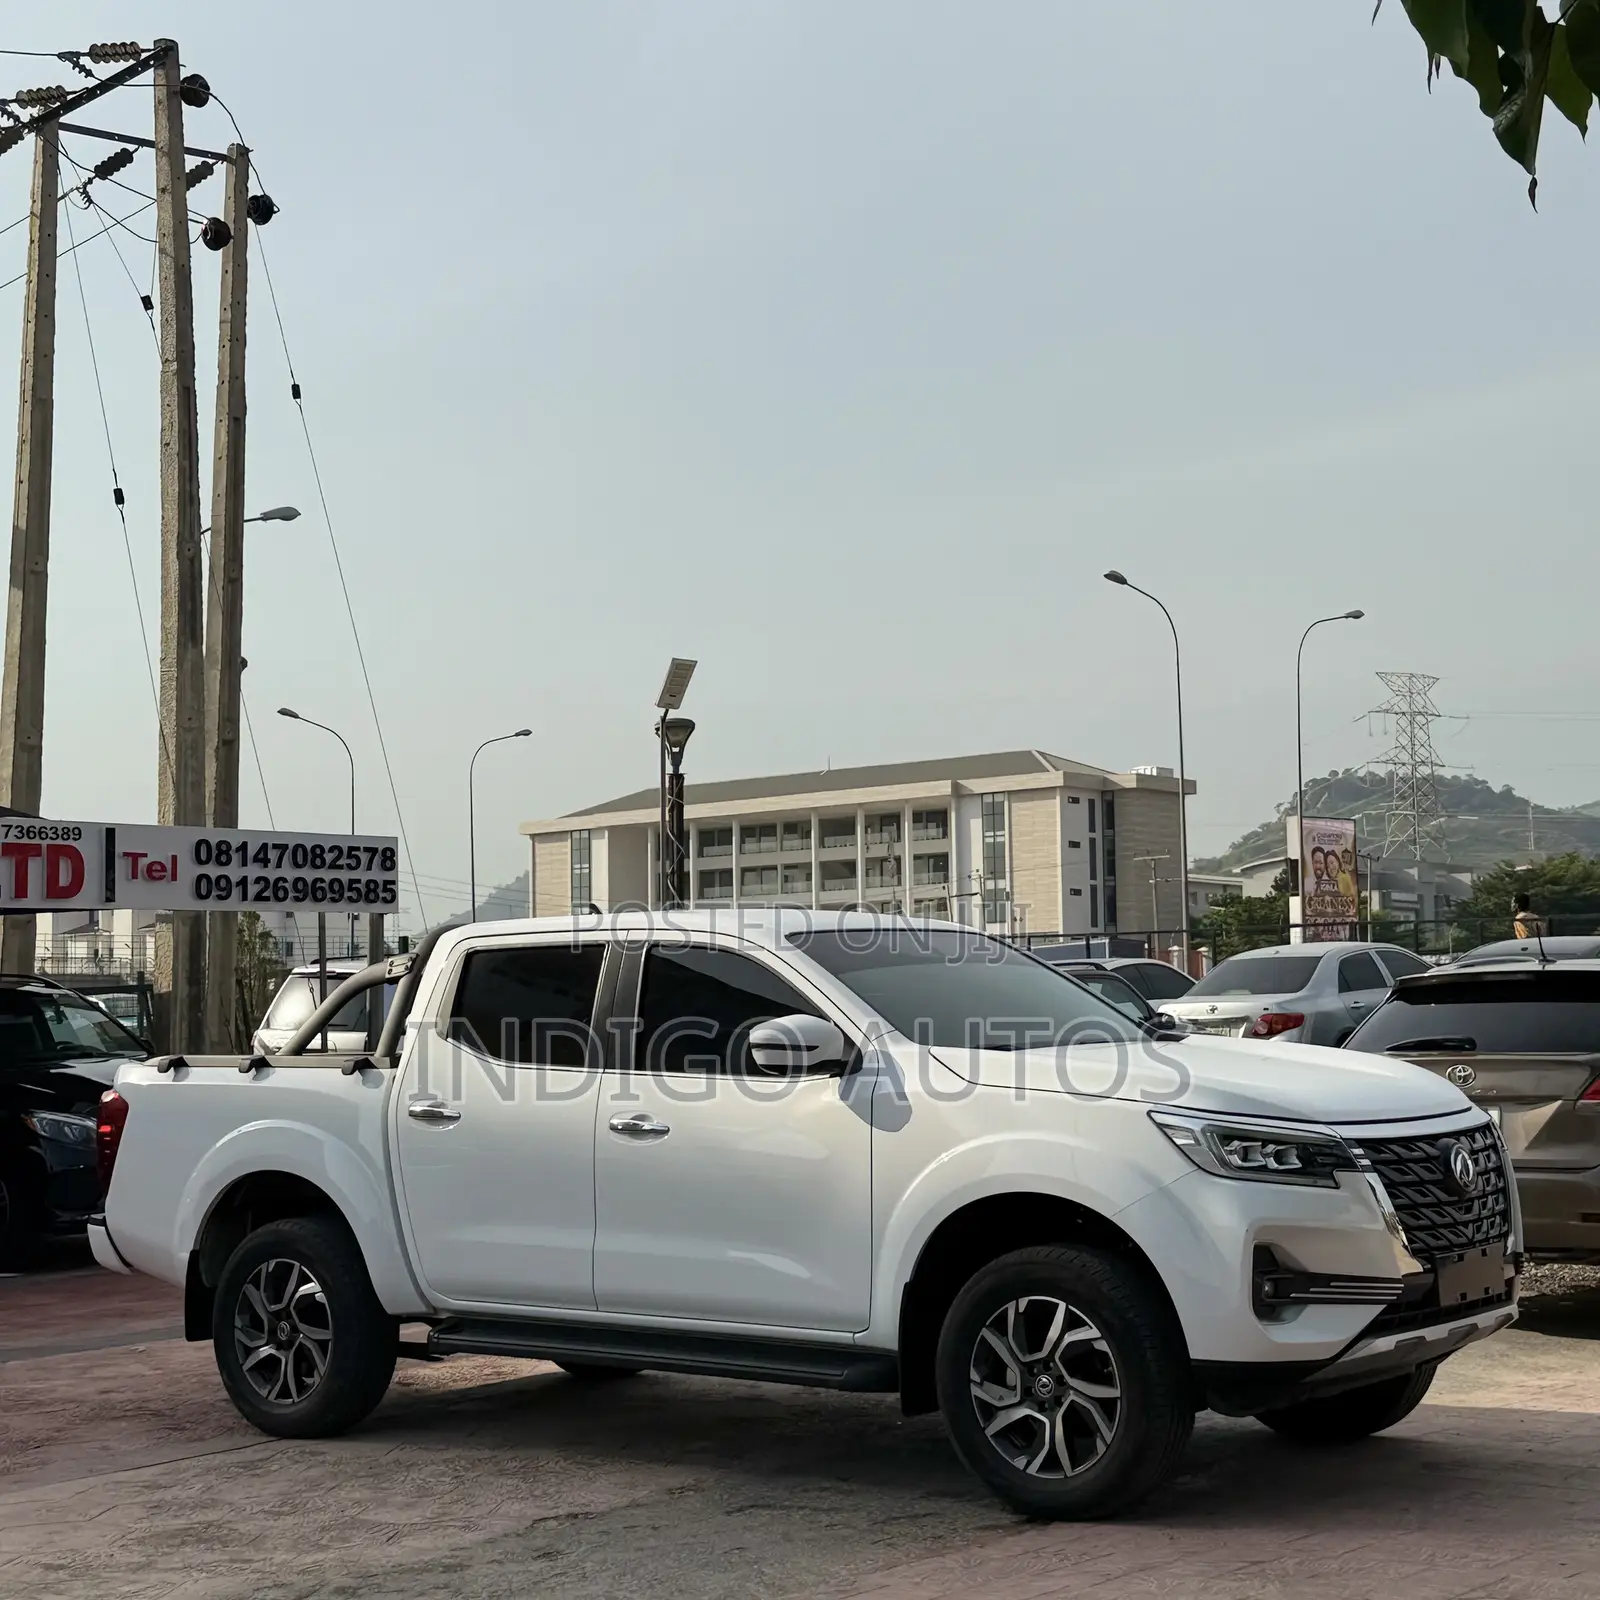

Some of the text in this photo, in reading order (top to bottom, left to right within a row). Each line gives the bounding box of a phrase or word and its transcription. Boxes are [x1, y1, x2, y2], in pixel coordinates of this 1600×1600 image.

[1, 824, 82, 841] 7366389
[122, 851, 178, 882] Tel
[194, 838, 396, 871] 08147082578
[0, 842, 85, 899] TD
[194, 873, 397, 904] 09126969585
